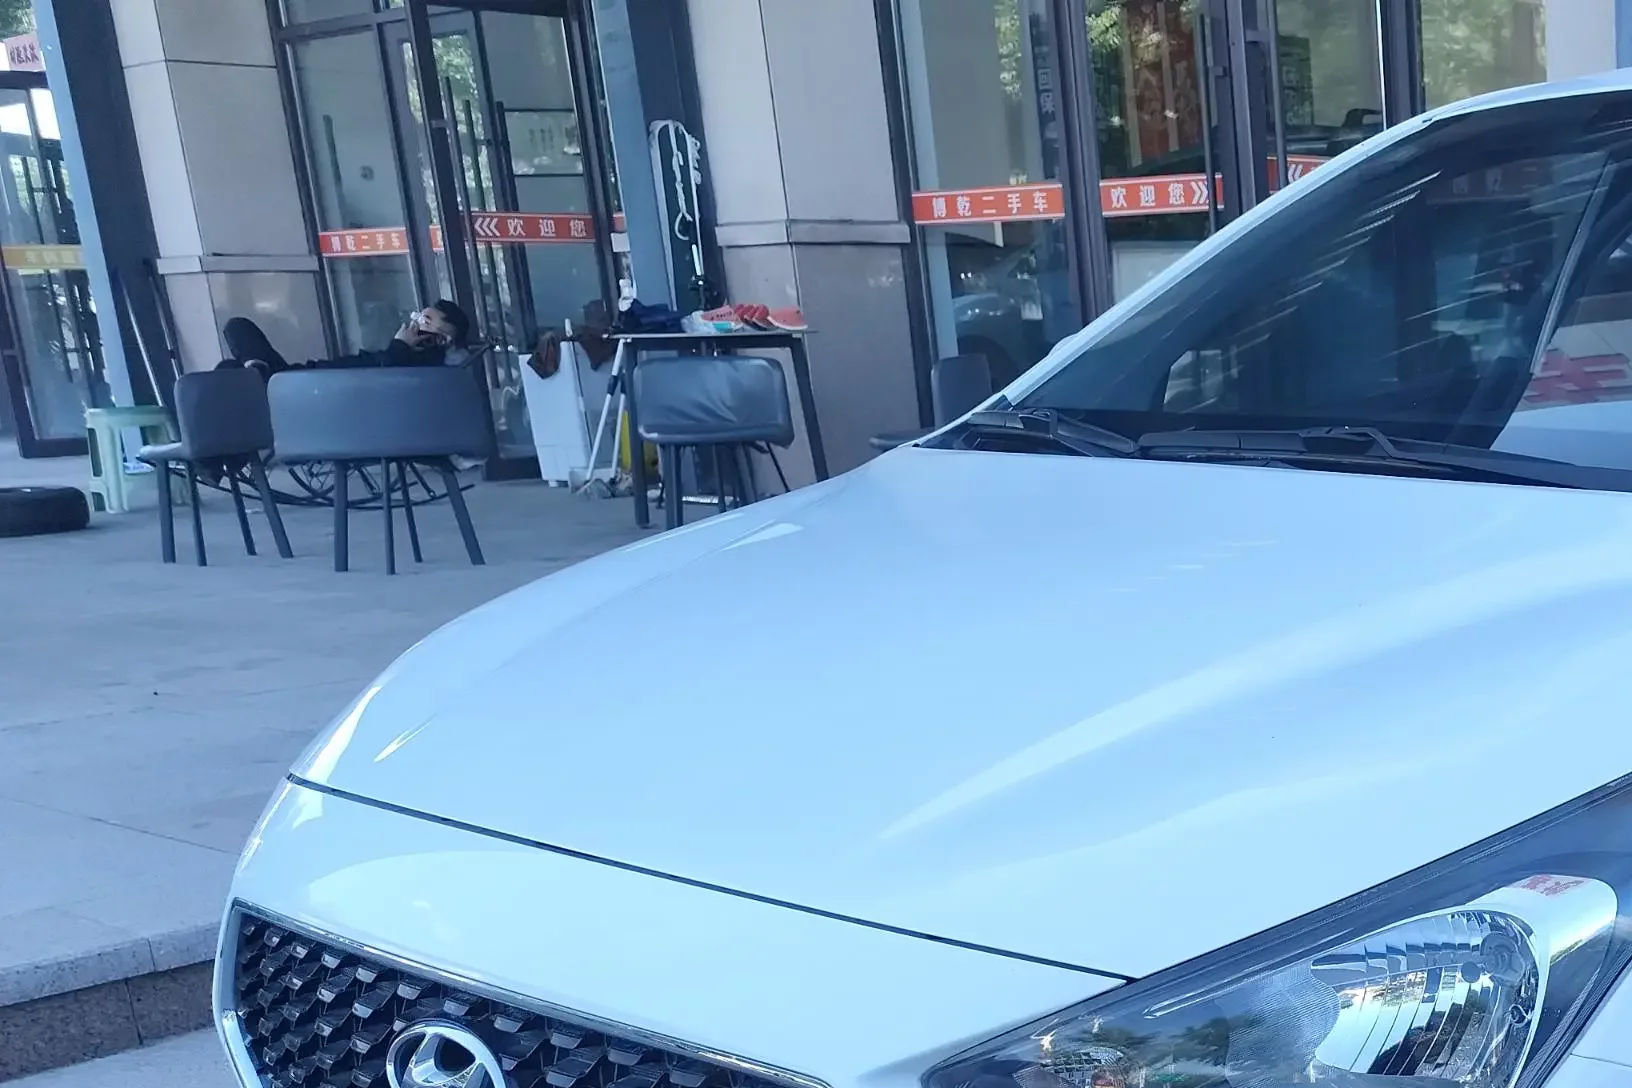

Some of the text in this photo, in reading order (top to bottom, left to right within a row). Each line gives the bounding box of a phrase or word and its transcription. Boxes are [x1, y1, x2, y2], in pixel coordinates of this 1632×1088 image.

[1110, 182, 1185, 209] 欢迎您
[507, 217, 587, 238] 欢迎您
